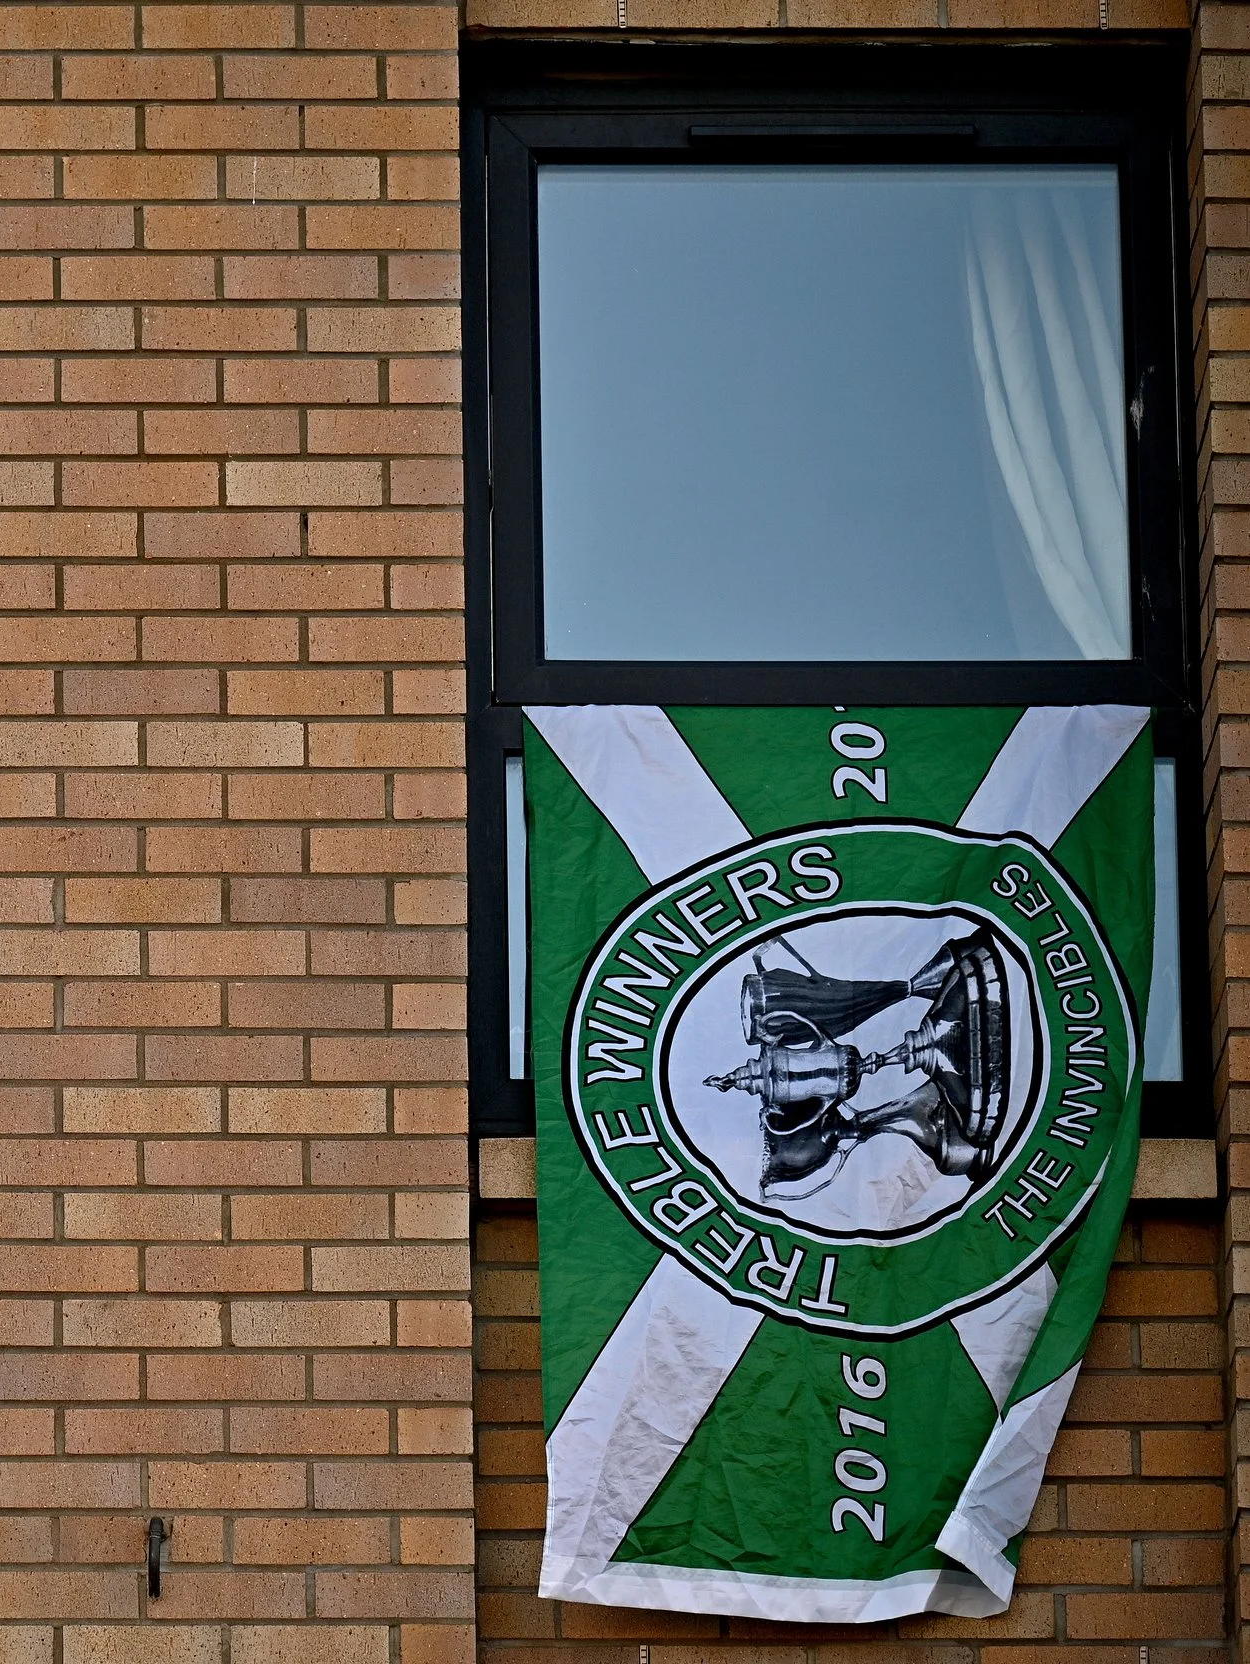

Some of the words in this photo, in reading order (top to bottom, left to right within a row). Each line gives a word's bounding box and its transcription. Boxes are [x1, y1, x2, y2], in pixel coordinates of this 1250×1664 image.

[586, 841, 844, 1085] WINNERS
[989, 861, 1108, 1147] INVINCIBLES
[589, 1104, 848, 1316] TREBLE
[983, 1158, 1074, 1241] THE
[831, 1352, 888, 1544] 2016
